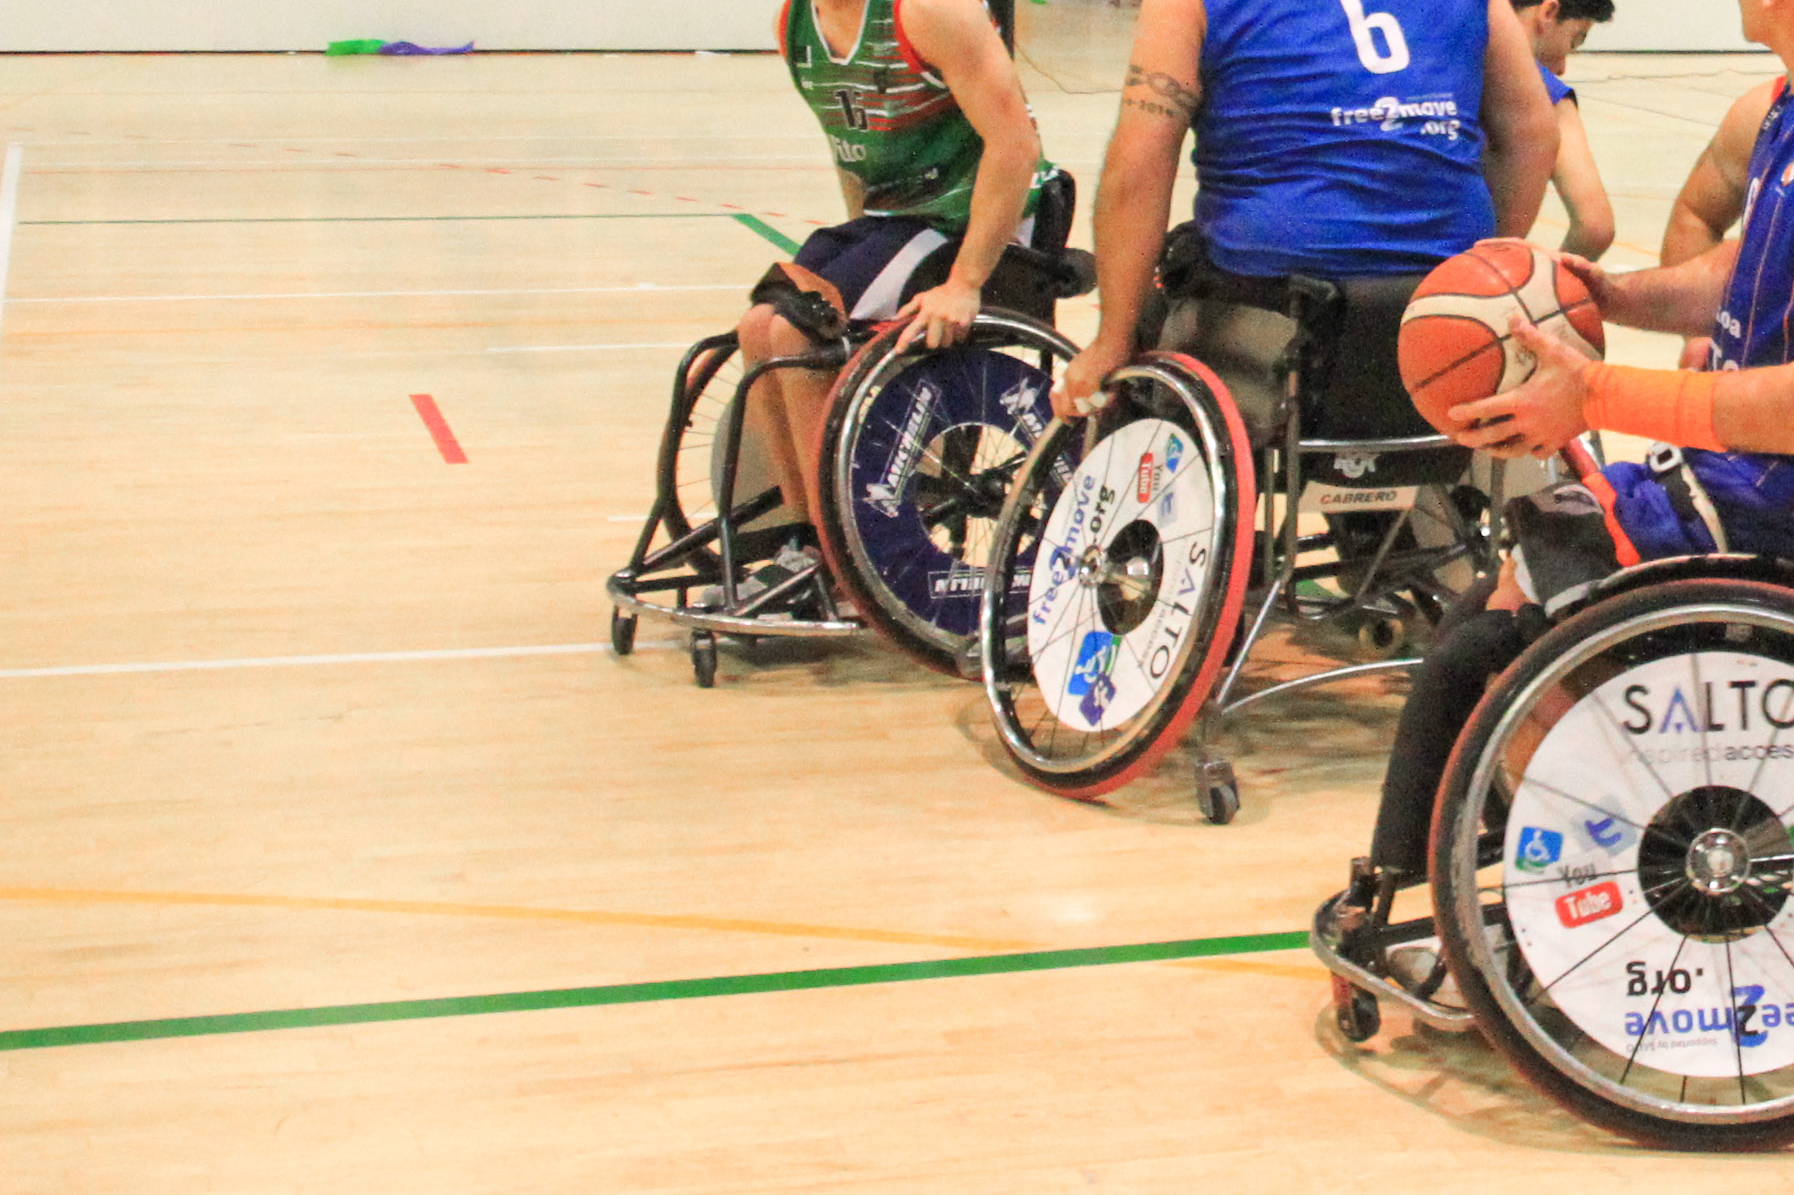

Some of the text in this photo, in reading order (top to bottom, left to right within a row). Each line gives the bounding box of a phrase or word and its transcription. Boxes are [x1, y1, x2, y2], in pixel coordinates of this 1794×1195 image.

[1331, 95, 1458, 132] free2move
[1420, 119, 1462, 141] .org
[1320, 490, 1398, 505] CABRERO
[1149, 541, 1208, 682] SALTO
[1557, 863, 1597, 887] You
[1564, 891, 1613, 920] Tube
[1625, 961, 1705, 998] .org
